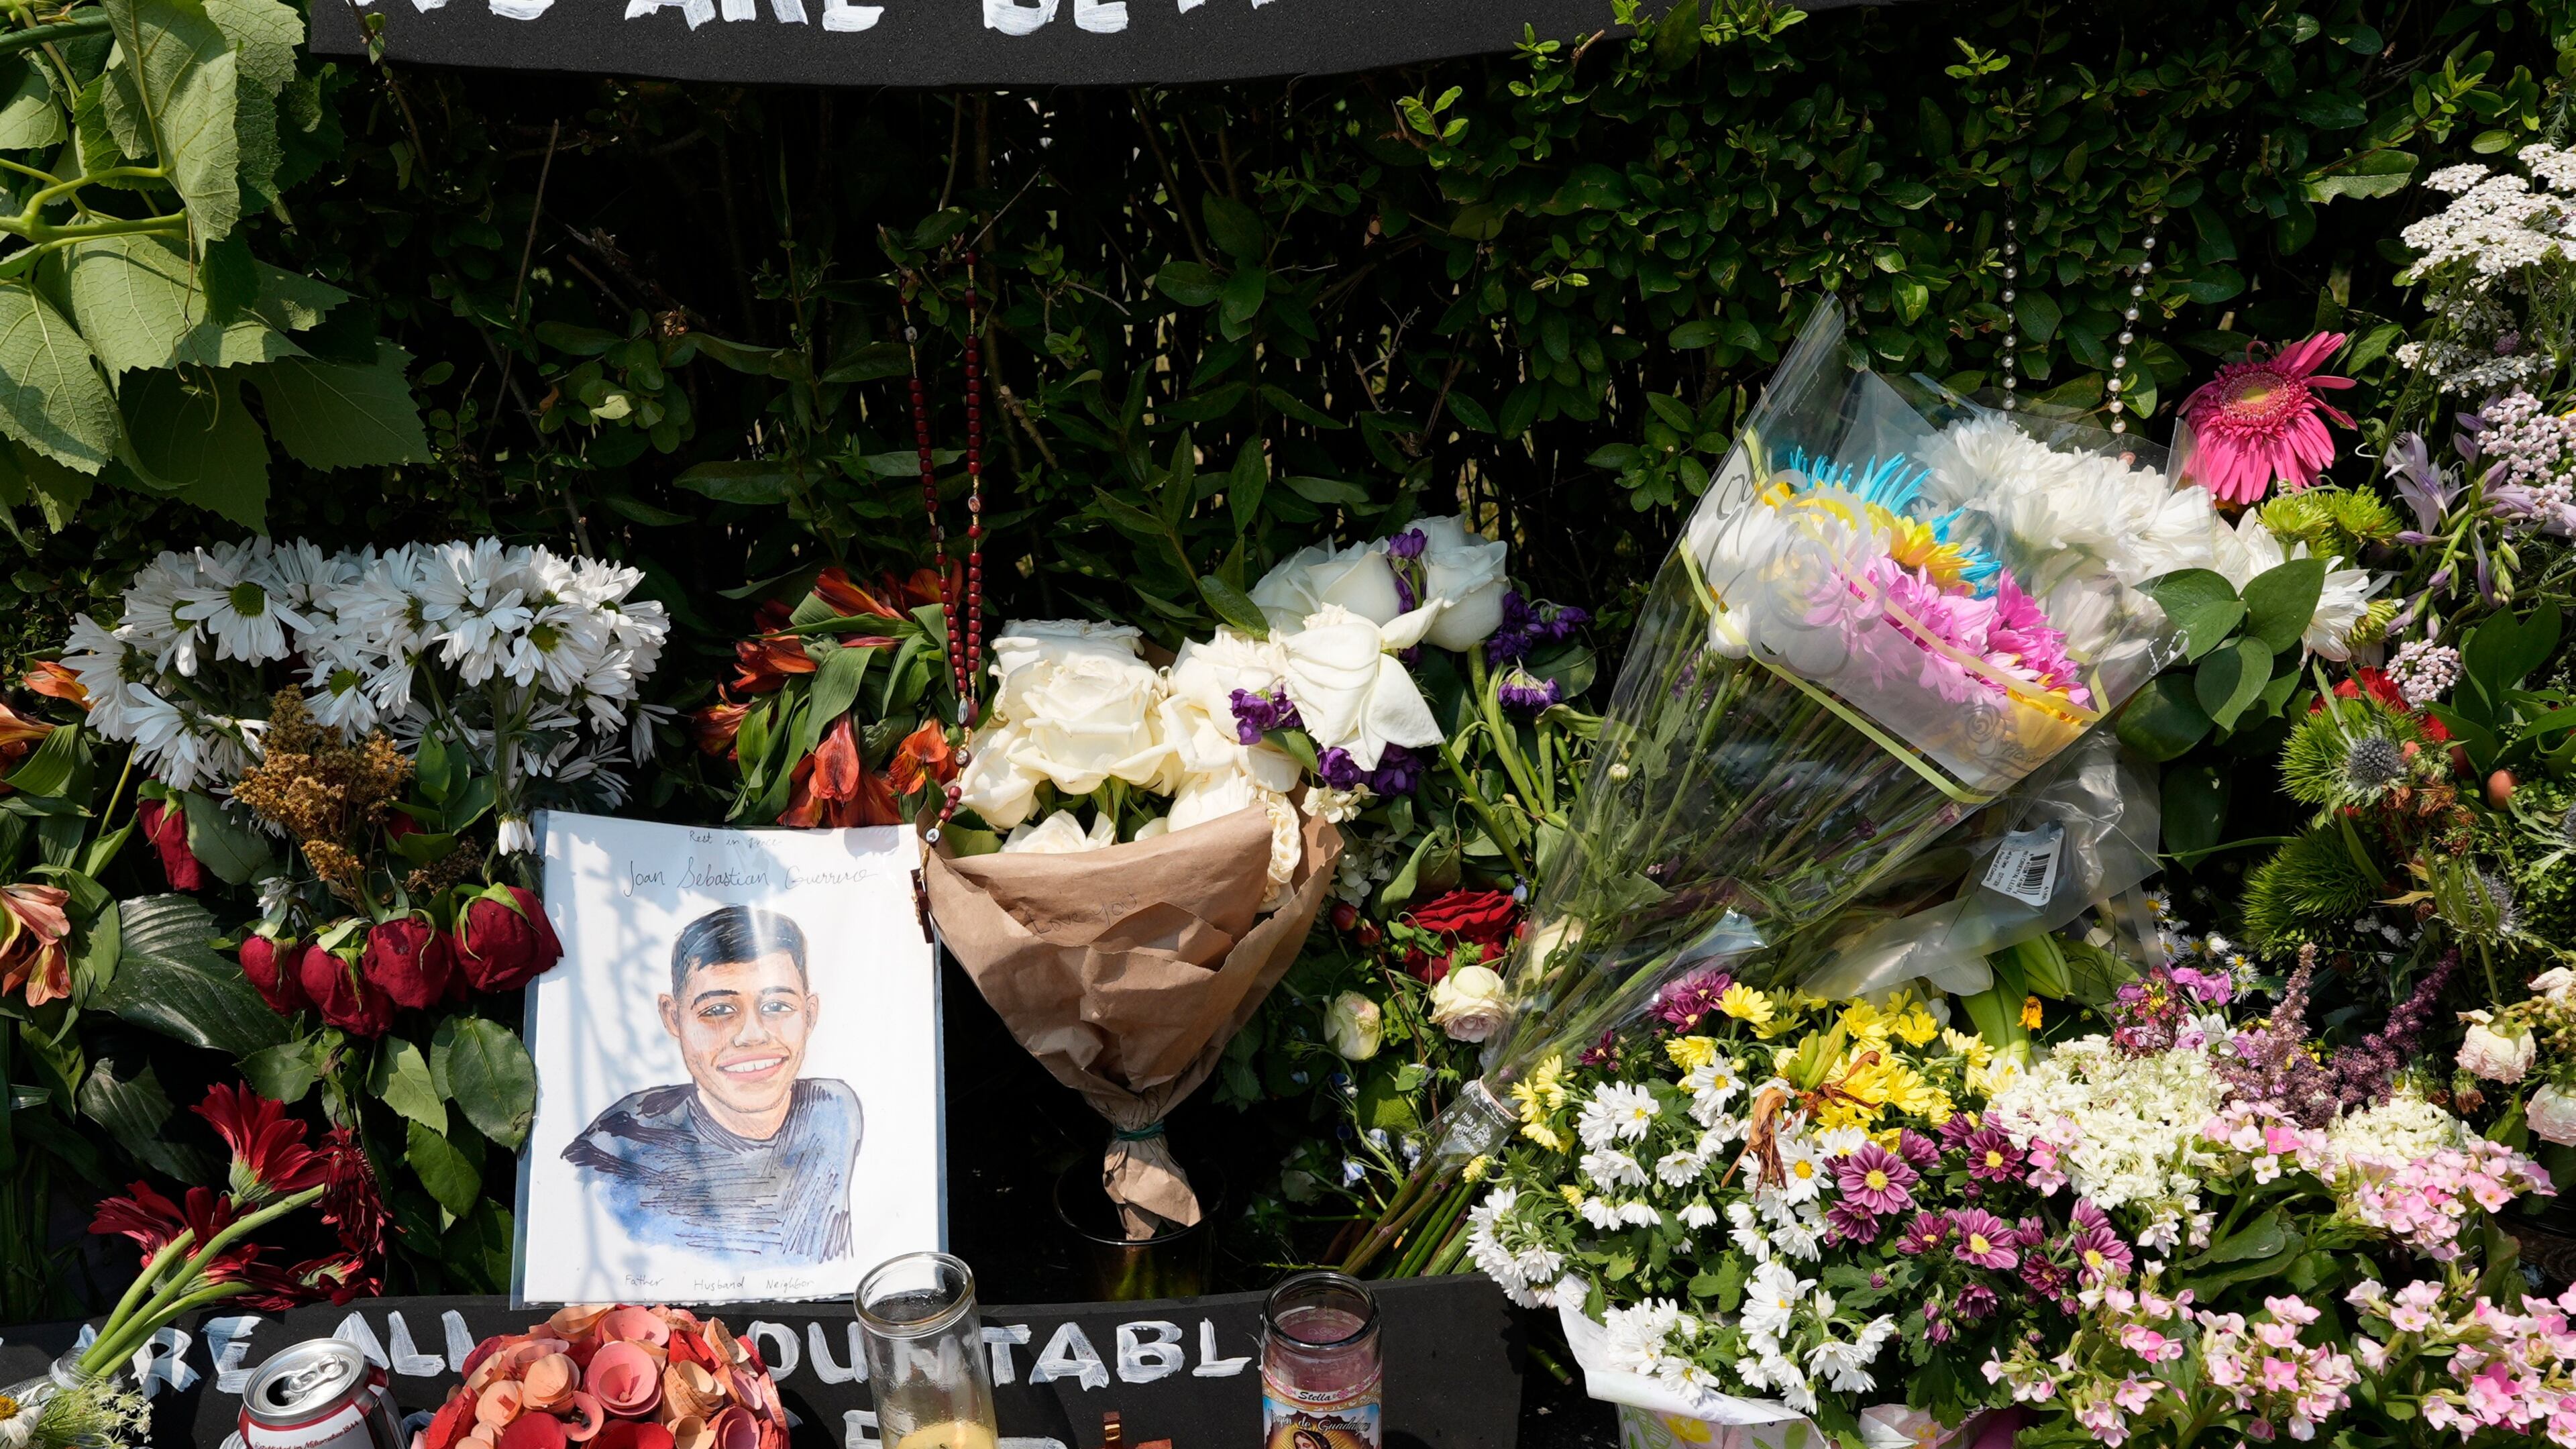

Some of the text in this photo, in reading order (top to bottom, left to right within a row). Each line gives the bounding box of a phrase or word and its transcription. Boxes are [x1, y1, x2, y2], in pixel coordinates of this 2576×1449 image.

[624, 861, 665, 897] Joan
[677, 857, 770, 889] Sebastian
[625, 1275, 664, 1287] Father
[694, 1277, 745, 1291] Husband
[1298, 1391, 1332, 1401] Stella
